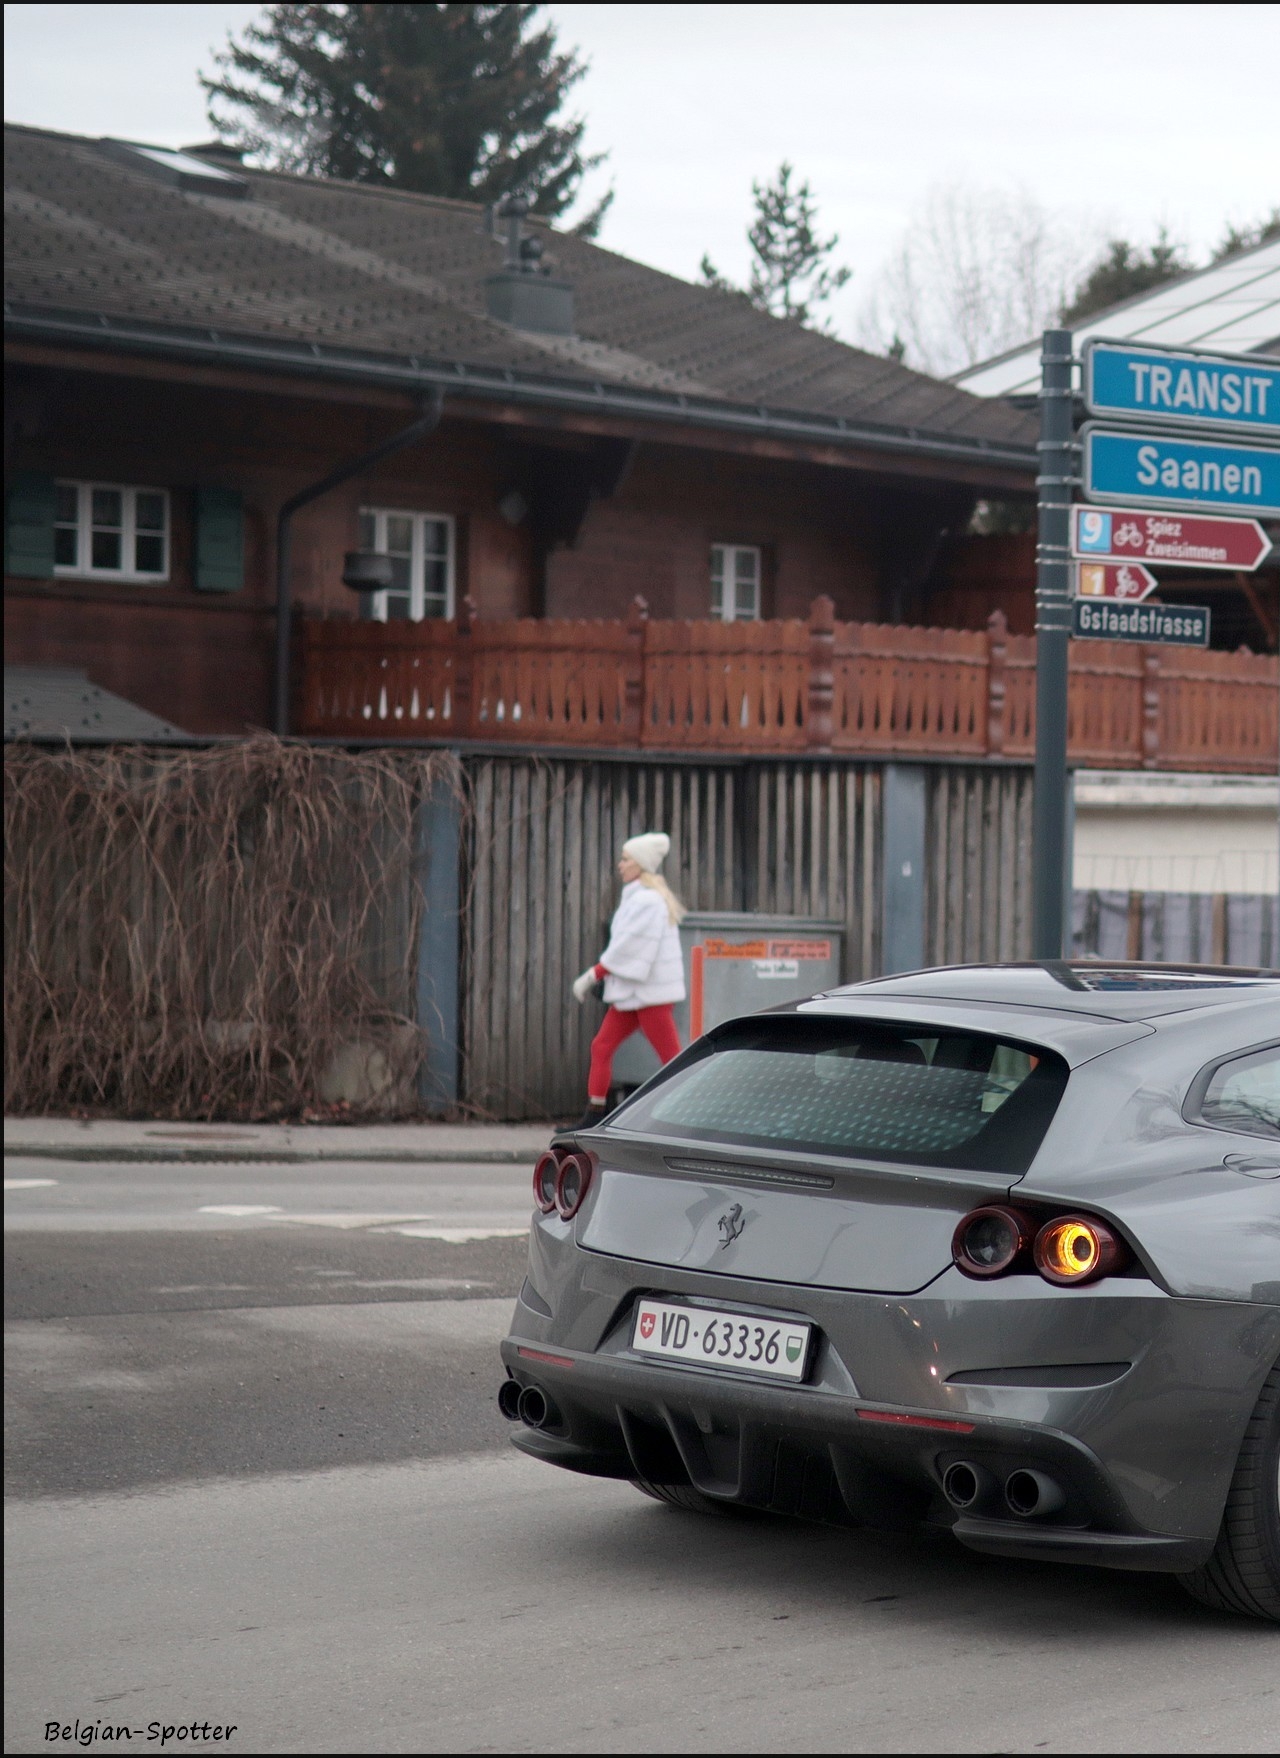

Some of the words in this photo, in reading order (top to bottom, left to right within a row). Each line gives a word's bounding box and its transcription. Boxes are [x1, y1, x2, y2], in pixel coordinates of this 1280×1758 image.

[1128, 362, 1273, 416] TRANSIT
[1136, 446, 1262, 496] Saanen
[1082, 512, 1103, 544] 9
[1145, 517, 1182, 538] Spiez
[1145, 539, 1228, 561] Zweisimmen
[1091, 571, 1105, 595] 1
[1079, 604, 1203, 636] Gstaadstrasse
